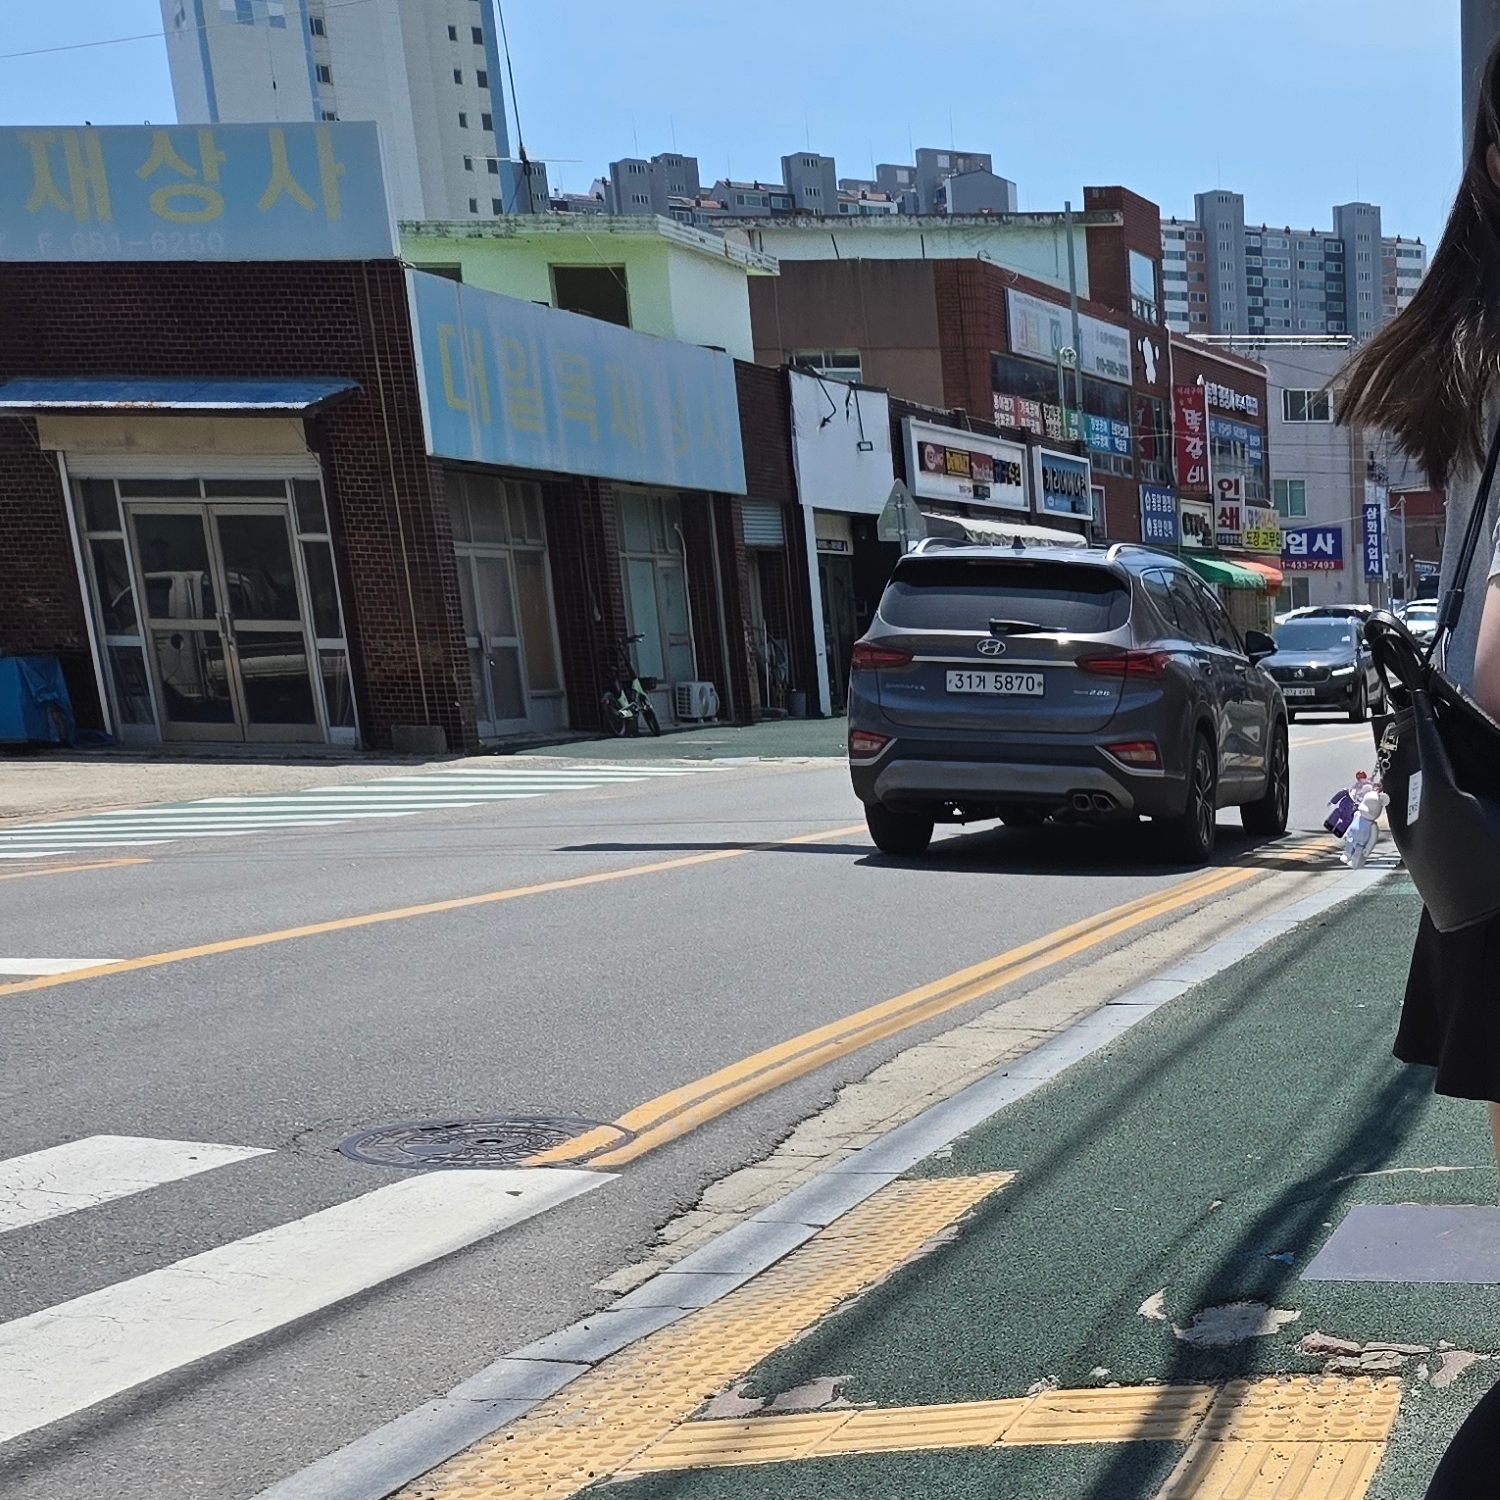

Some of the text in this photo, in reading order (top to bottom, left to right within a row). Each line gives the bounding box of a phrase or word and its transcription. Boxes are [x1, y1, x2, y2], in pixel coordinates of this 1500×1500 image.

[17, 128, 346, 223] 재상사
[1217, 478, 1240, 531] 인쇄
[1366, 507, 1380, 574] 삼화지업사
[955, 673, 1035, 692] 31거 5870
